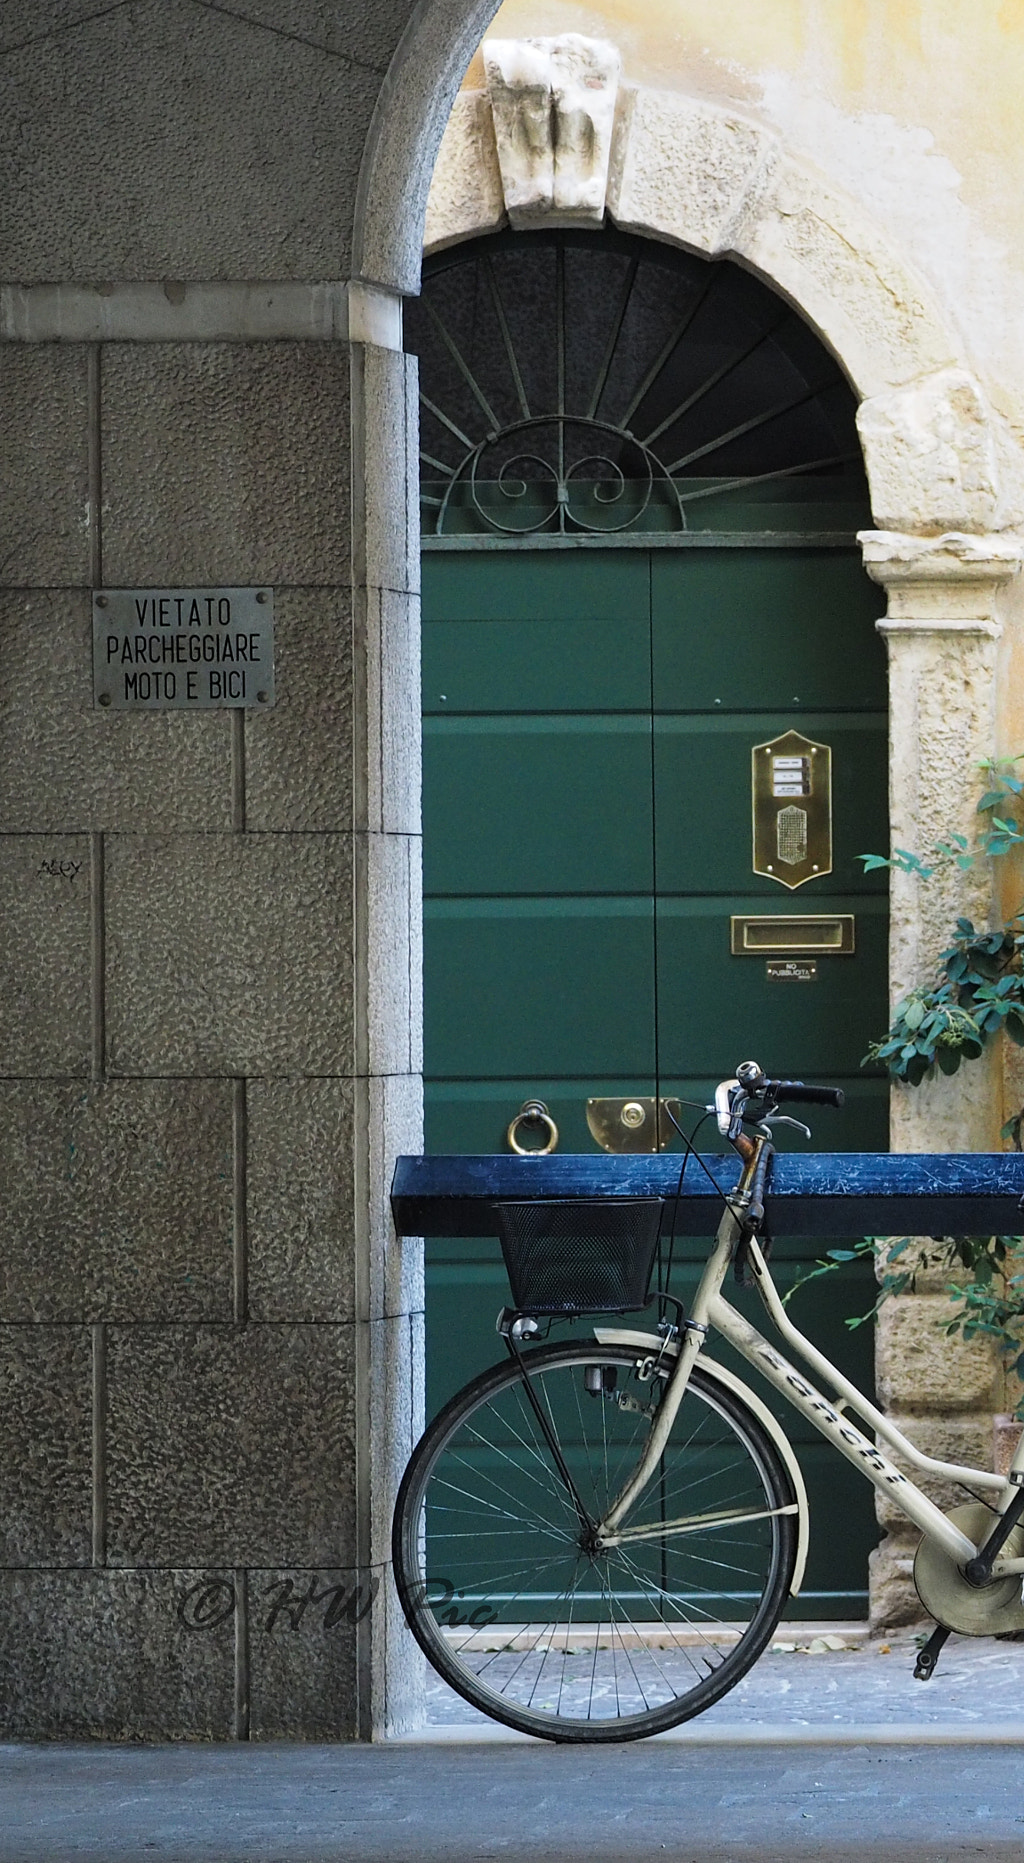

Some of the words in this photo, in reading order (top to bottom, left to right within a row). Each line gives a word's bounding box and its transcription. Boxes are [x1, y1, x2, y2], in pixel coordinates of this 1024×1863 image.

[135, 598, 231, 627] VIETATO
[106, 634, 261, 664] PARCHEGGIARE
[124, 672, 177, 700] MOTO
[187, 671, 199, 700] E
[209, 670, 246, 699] BICI
